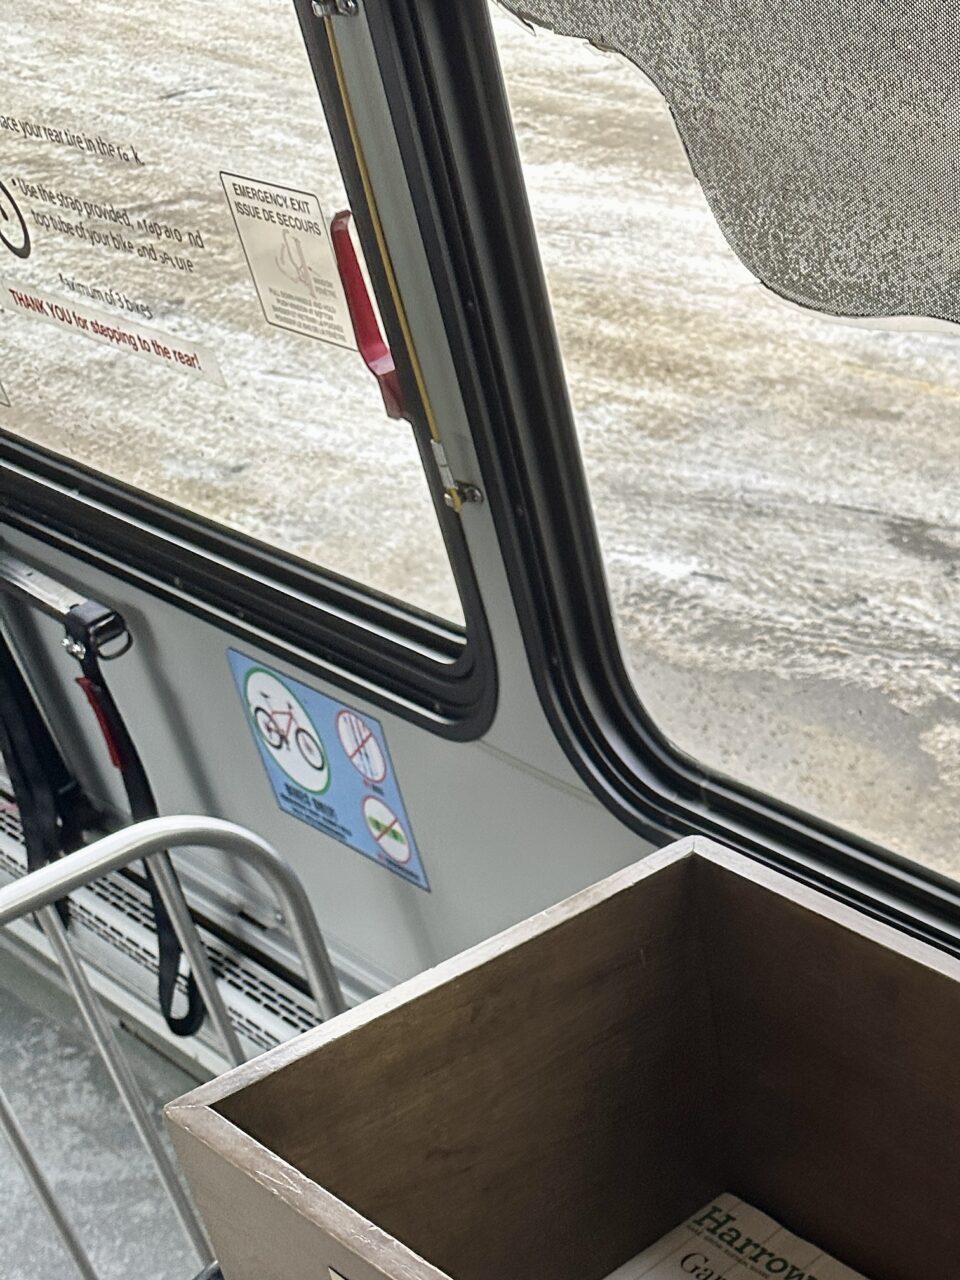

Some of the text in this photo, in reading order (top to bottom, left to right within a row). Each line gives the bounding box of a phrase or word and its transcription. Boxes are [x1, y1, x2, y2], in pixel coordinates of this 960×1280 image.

[18, 120, 42, 139] your
[42, 125, 64, 145] rear
[65, 129, 82, 150] tire
[83, 133, 95, 153] in
[95, 136, 114, 157] the
[117, 145, 146, 166] rak.
[17, 178, 36, 198] Use
[37, 183, 55, 205] the
[57, 193, 82, 214] strap
[232, 183, 309, 215] EMERGENCY EXIT
[31, 209, 50, 229] top
[51, 214, 74, 235] tube
[75, 221, 87, 240] of
[86, 229, 110, 248] your
[234, 201, 322, 236] ISSUE DE SECOURS
[9, 288, 201, 370] THANK YOU for stepping to the rear!
